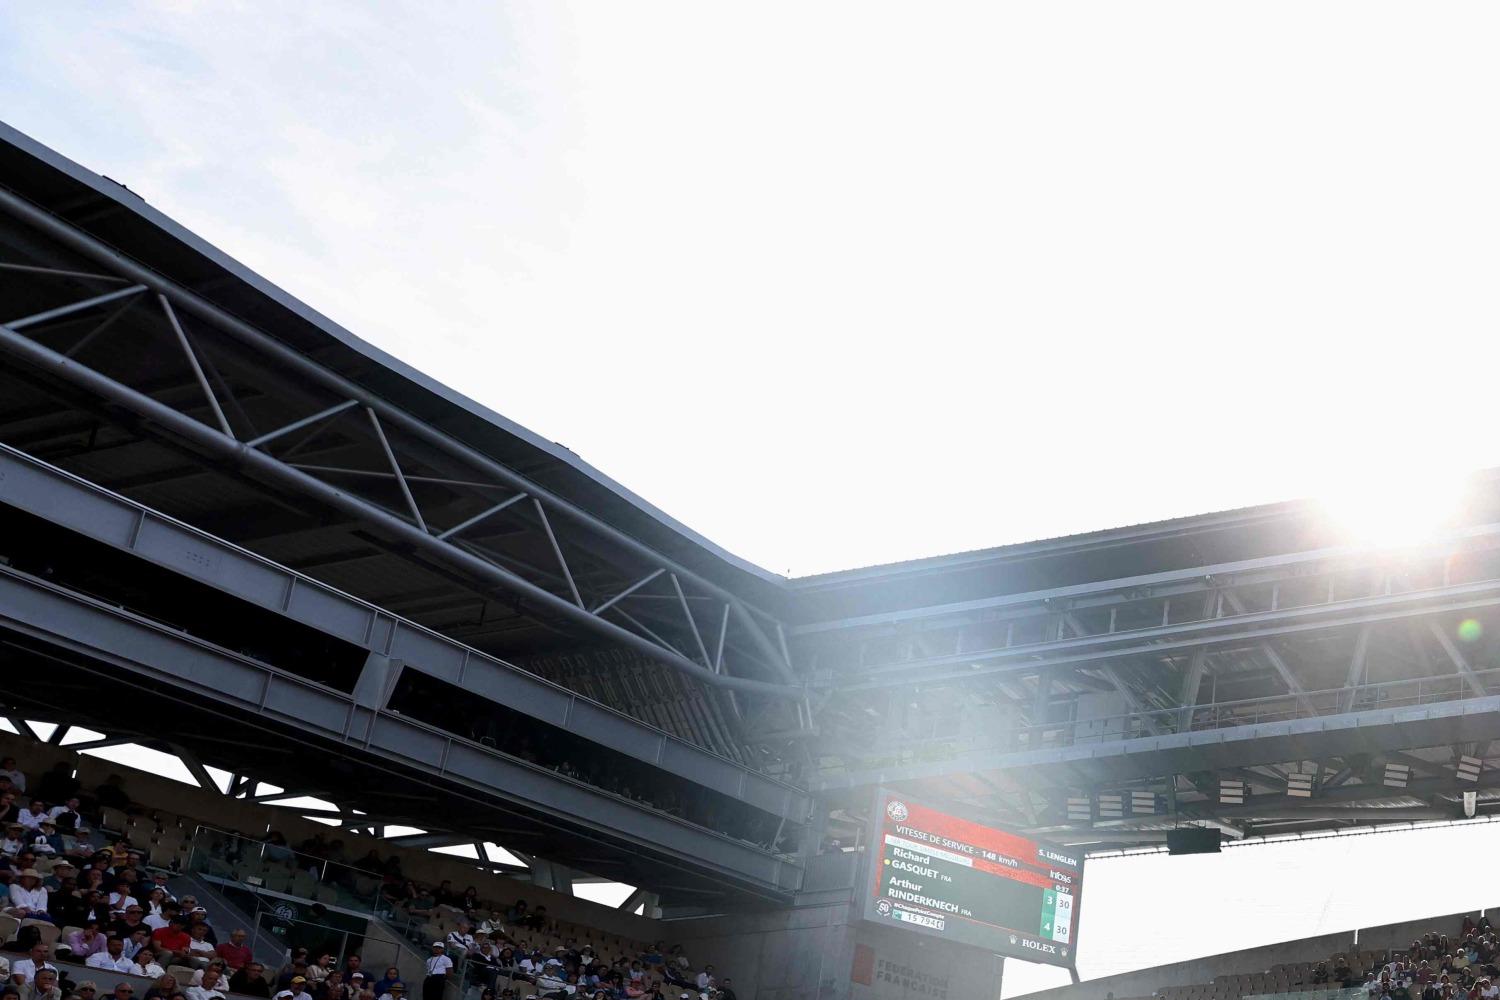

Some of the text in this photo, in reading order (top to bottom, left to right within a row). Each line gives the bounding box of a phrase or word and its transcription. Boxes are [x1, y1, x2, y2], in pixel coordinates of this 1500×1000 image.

[896, 824, 928, 841] VITESSE
[929, 834, 941, 845] DE
[942, 838, 974, 854] SERVICE
[982, 850, 996, 861] 148
[999, 855, 1018, 867] km/h
[893, 847, 930, 864] Richard
[1047, 851, 1077, 866] LENGLEN
[892, 860, 952, 883] GASQUET FRA
[889, 876, 922, 892] Arthur
[888, 888, 972, 917] RINDERKNECH FRA
[1047, 896, 1070, 909] 3 30
[1043, 922, 1067, 935] 4 30
[1022, 939, 1056, 953] ROLEX
